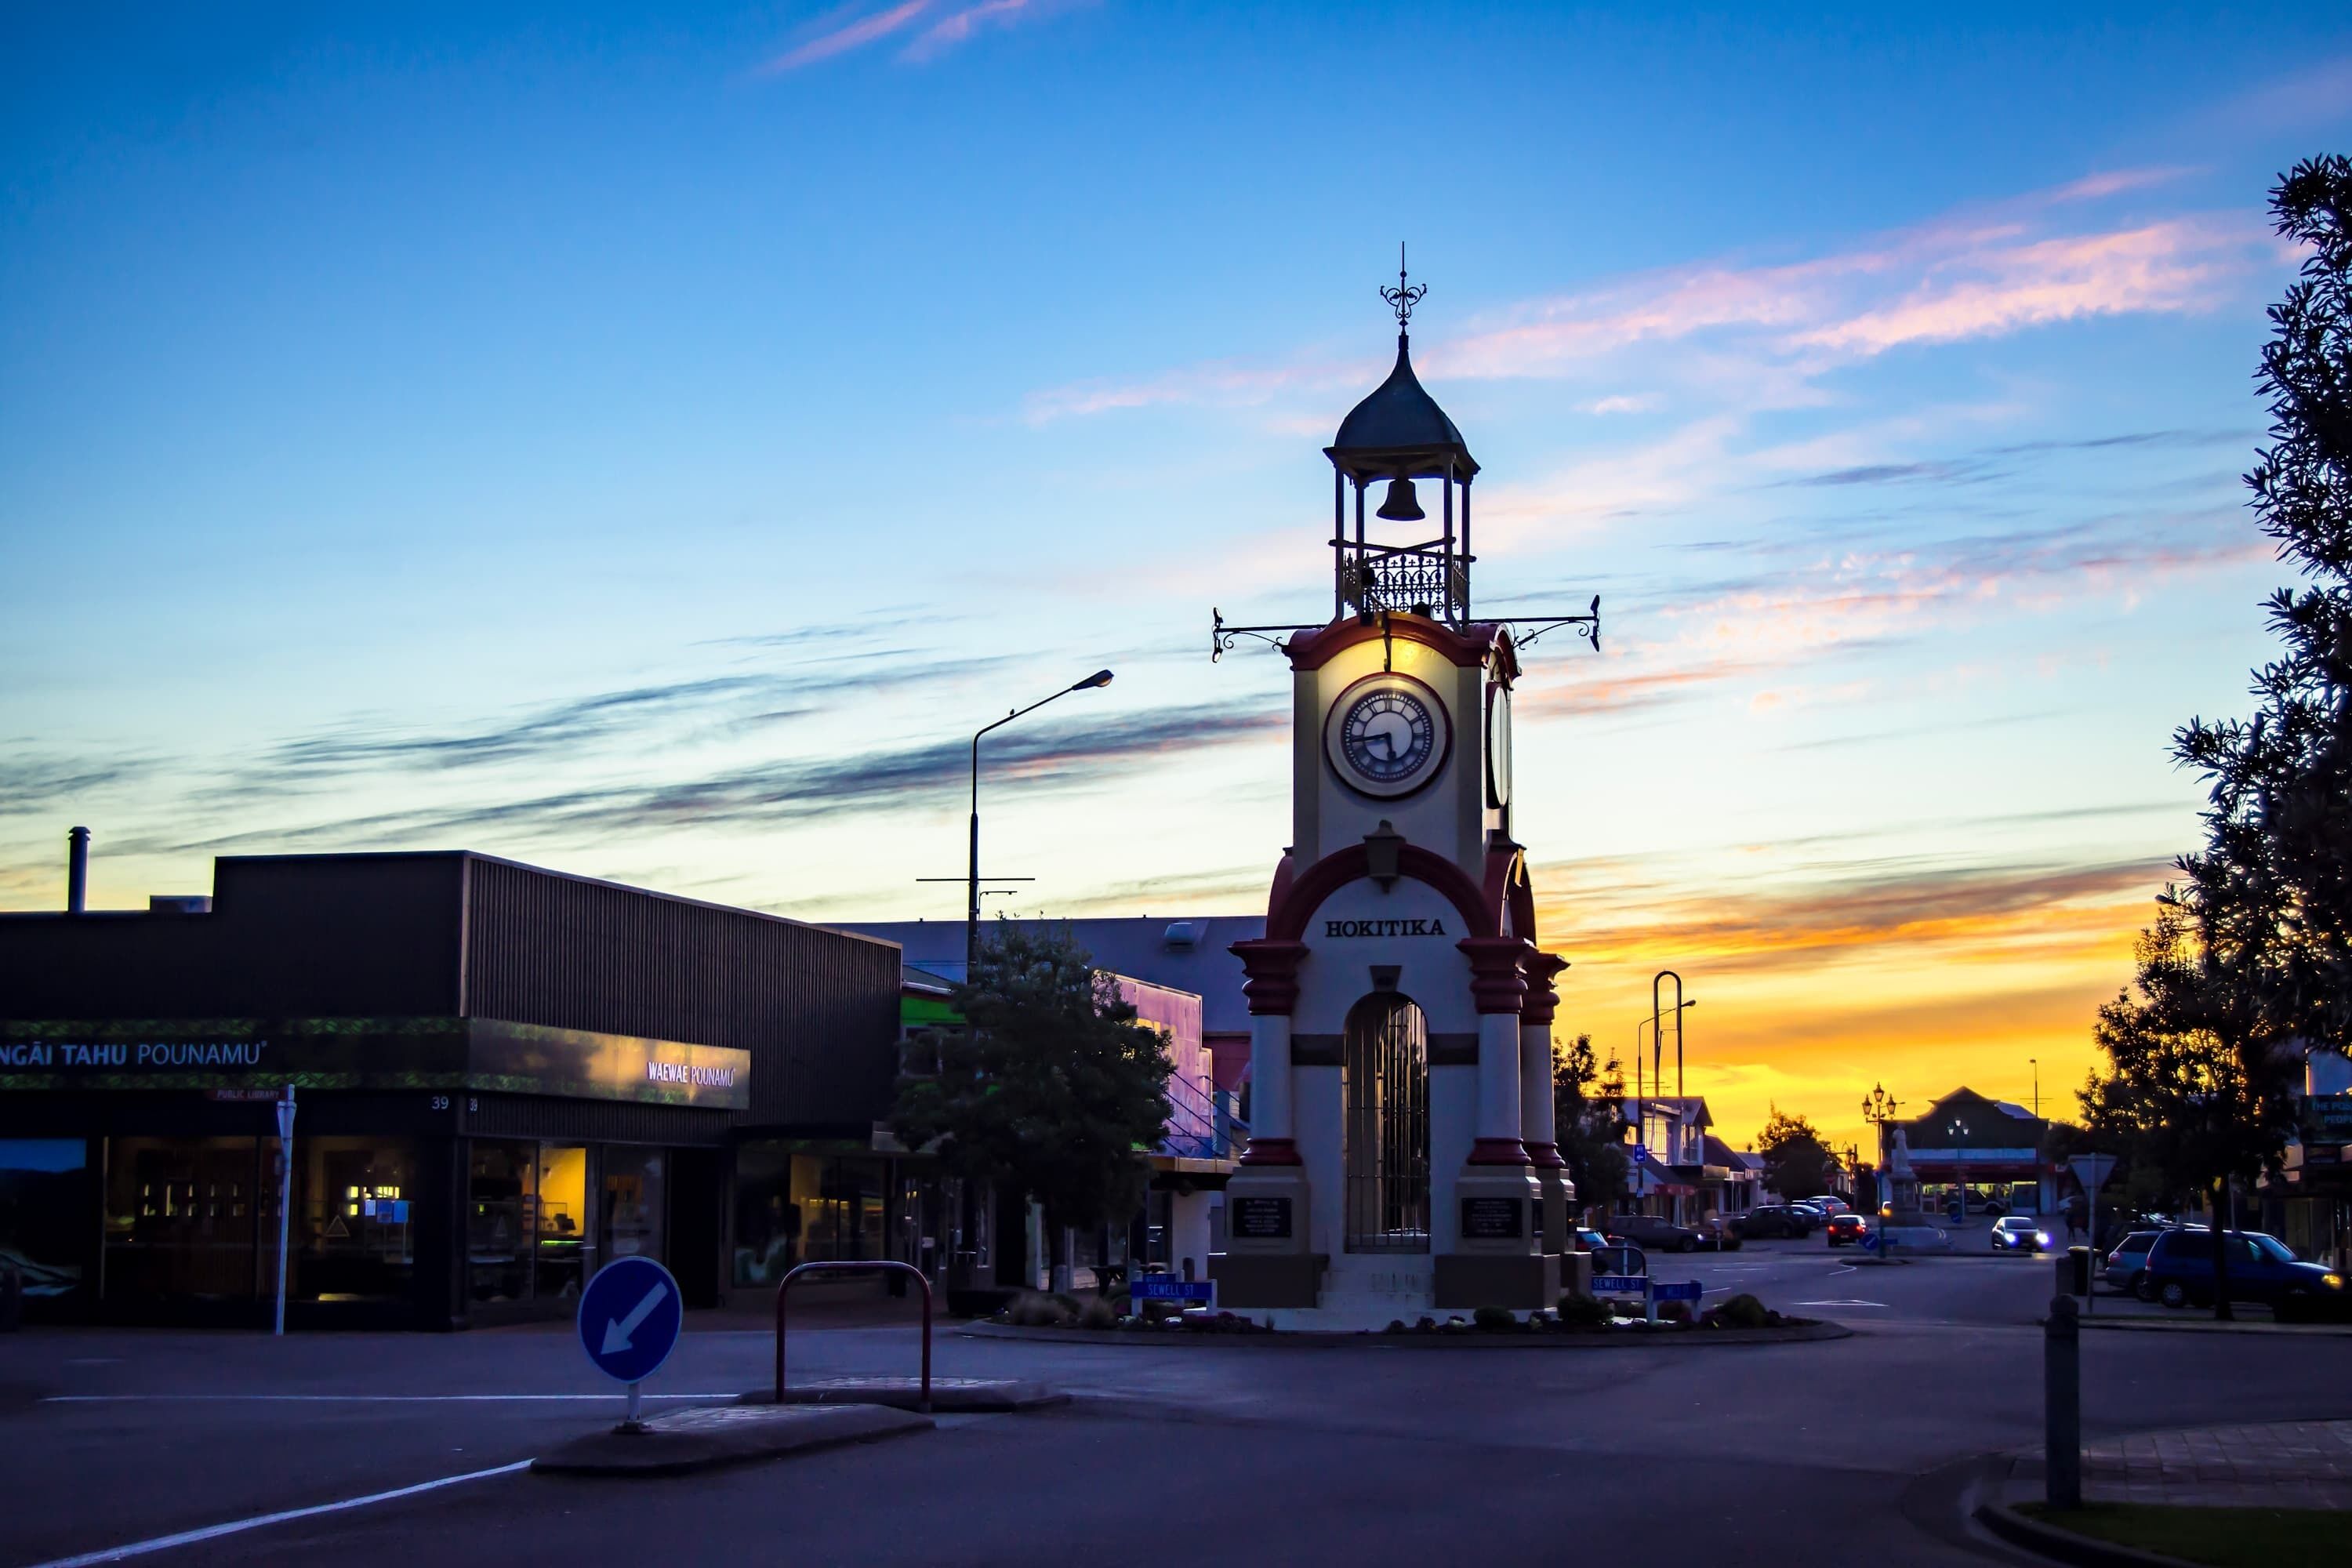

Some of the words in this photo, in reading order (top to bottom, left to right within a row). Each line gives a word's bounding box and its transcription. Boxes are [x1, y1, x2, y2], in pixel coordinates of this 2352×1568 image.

[1326, 919, 1446, 937] HOKITIKA
[60, 1044, 127, 1066] TAHU
[137, 1043, 262, 1066] POUNAMU
[648, 1062, 688, 1083] WAEWAE
[691, 1066, 735, 1087] POUNAMU
[217, 1090, 245, 1098] PUBLIC
[248, 1090, 280, 1098] LIBRARY
[432, 1095, 449, 1109] 39
[470, 1097, 477, 1111] 39
[1148, 1283, 1179, 1296] SEWELL
[1185, 1283, 1194, 1296] ST
[1593, 1278, 1628, 1290] SEWELL
[1631, 1279, 1642, 1290] ST
